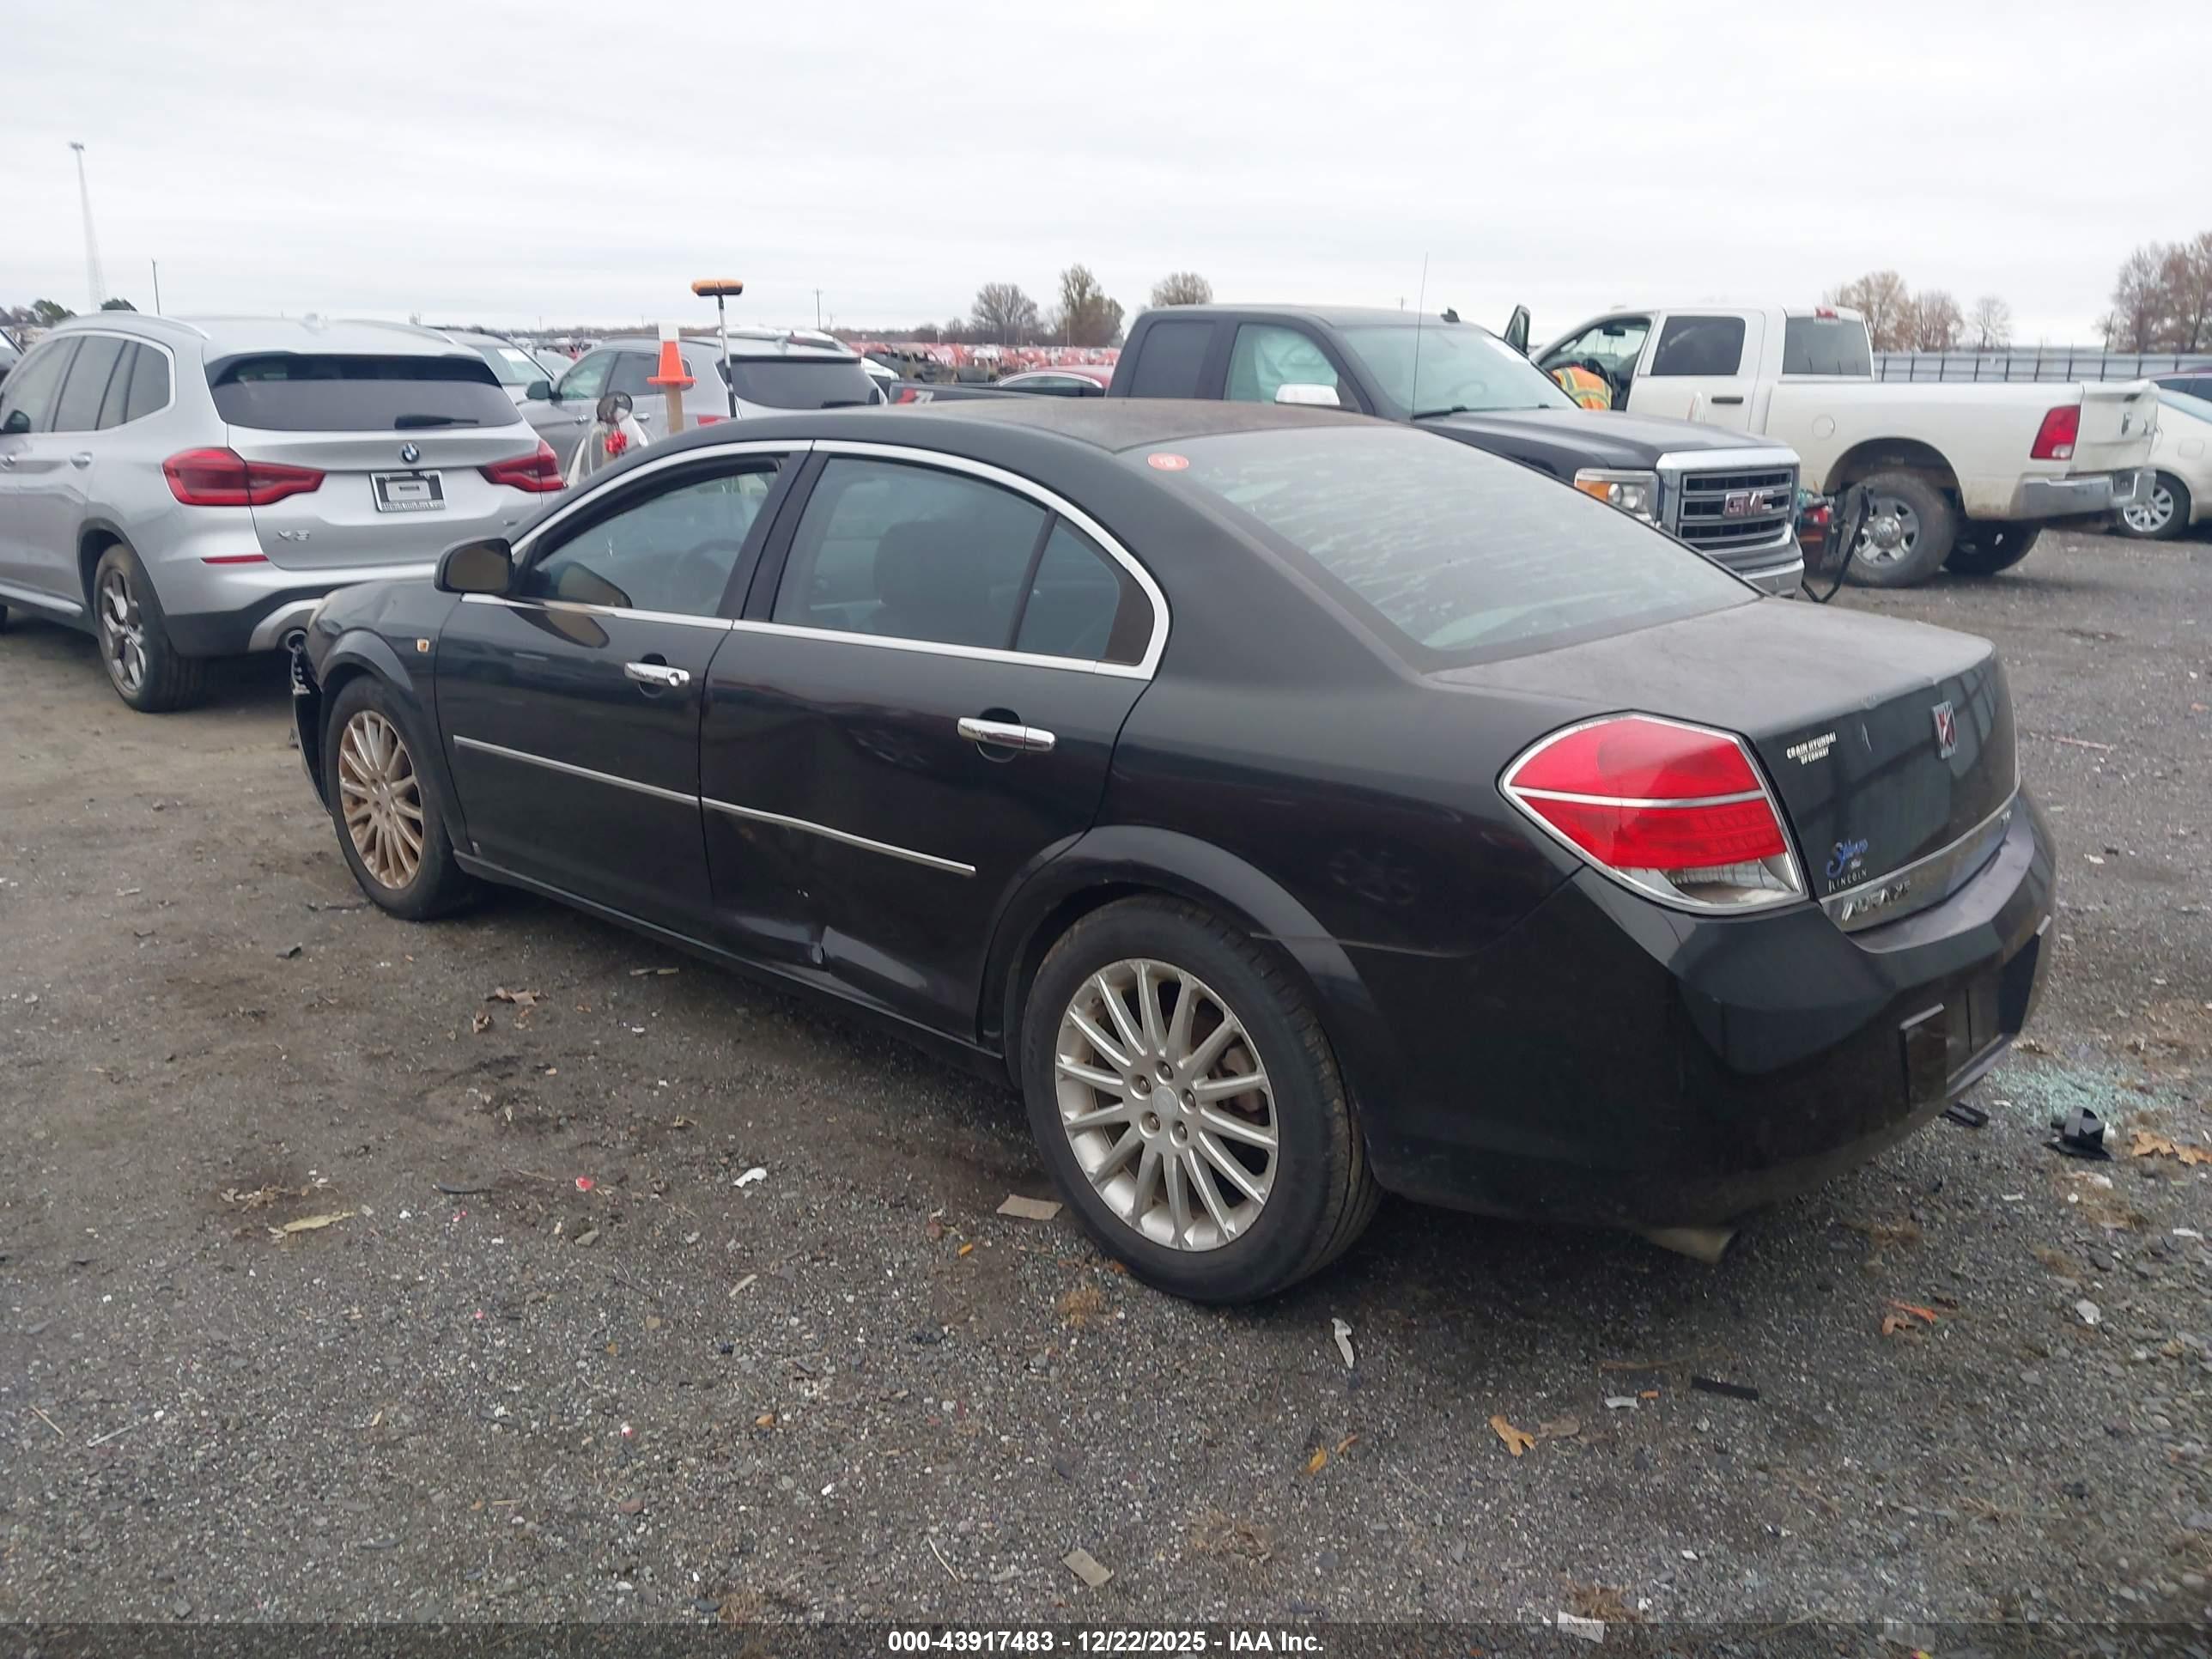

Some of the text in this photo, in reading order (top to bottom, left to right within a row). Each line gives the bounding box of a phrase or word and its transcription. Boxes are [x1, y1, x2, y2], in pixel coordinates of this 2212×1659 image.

[1725, 489, 1774, 517] GMC
[276, 529, 310, 542] X3
[1808, 731, 1837, 751] HYUNDAI
[1830, 867, 1868, 891] LINCOLN
